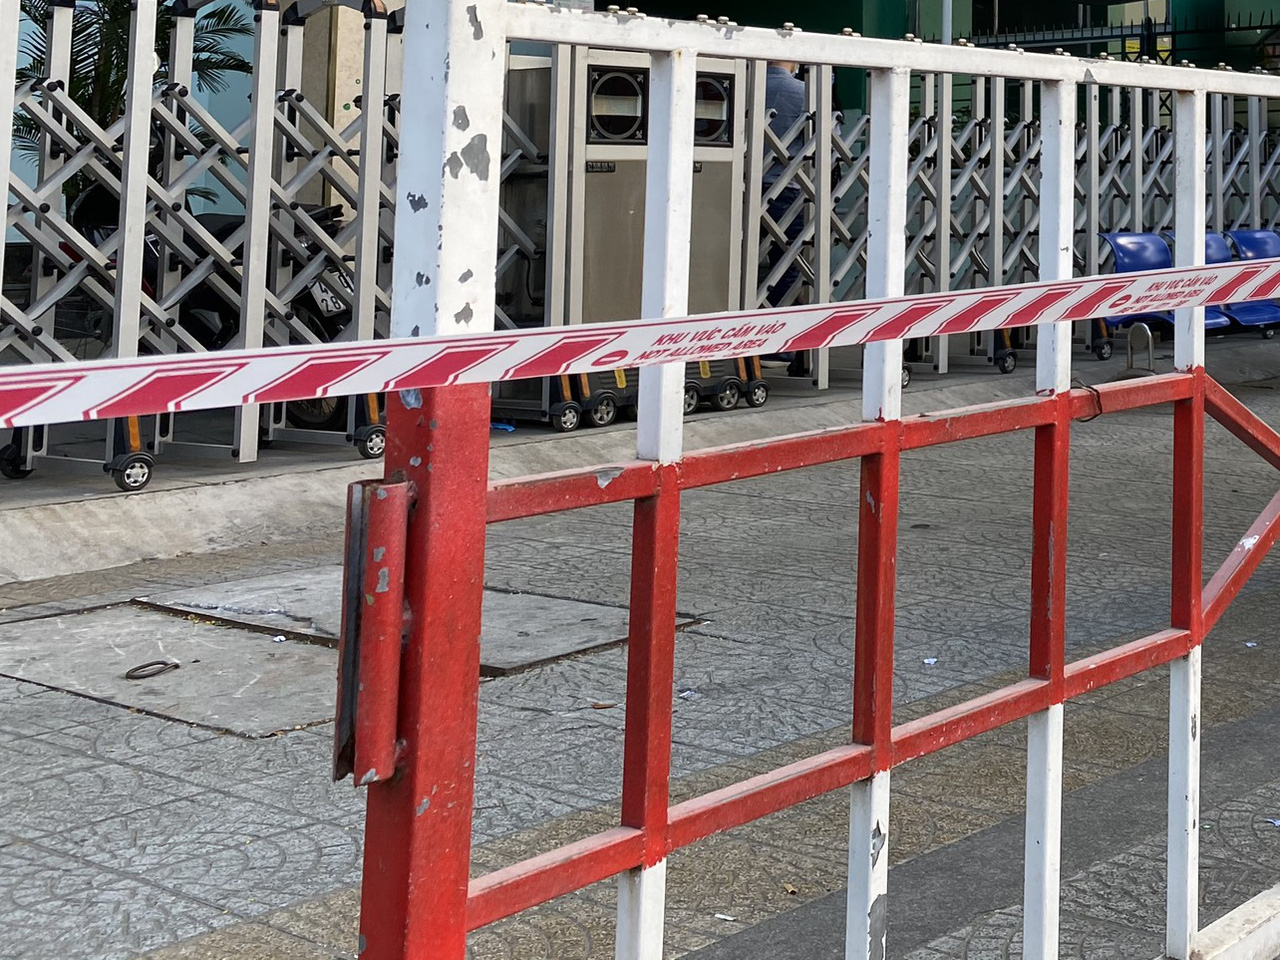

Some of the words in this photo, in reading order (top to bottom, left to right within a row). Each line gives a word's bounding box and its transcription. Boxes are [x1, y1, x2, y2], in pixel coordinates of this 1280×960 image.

[651, 332, 691, 347] KHU
[633, 349, 671, 361] NOT
[665, 342, 733, 358] ALLOWED
[728, 338, 769, 350] AREA
